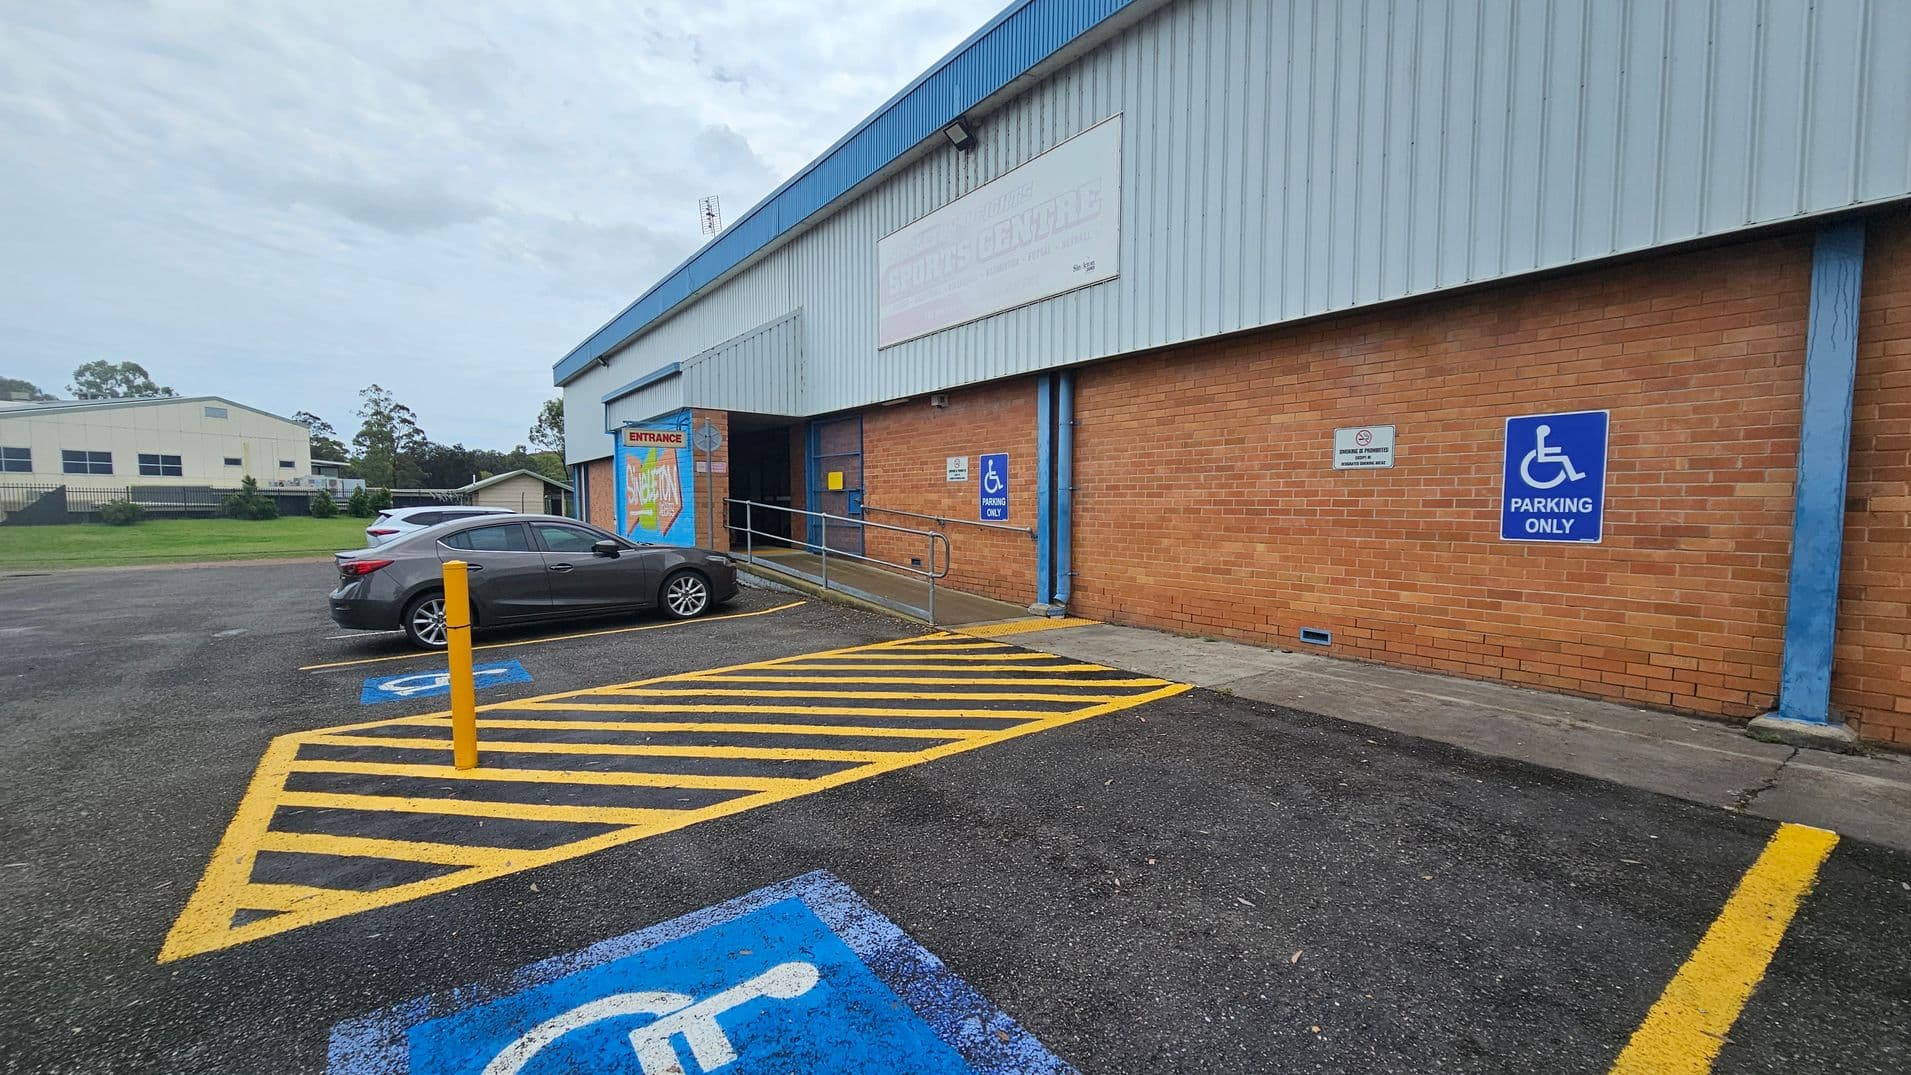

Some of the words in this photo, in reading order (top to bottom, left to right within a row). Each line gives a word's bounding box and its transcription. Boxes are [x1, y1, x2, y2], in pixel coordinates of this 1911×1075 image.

[888, 234, 970, 298] SPORTS
[978, 179, 1102, 262] CENTRE
[629, 431, 682, 443] ENTRANCE
[982, 497, 1006, 506] PARKING
[1510, 497, 1593, 513] PARKING
[986, 508, 1001, 517] ONLY
[1525, 518, 1575, 534] ONLY
